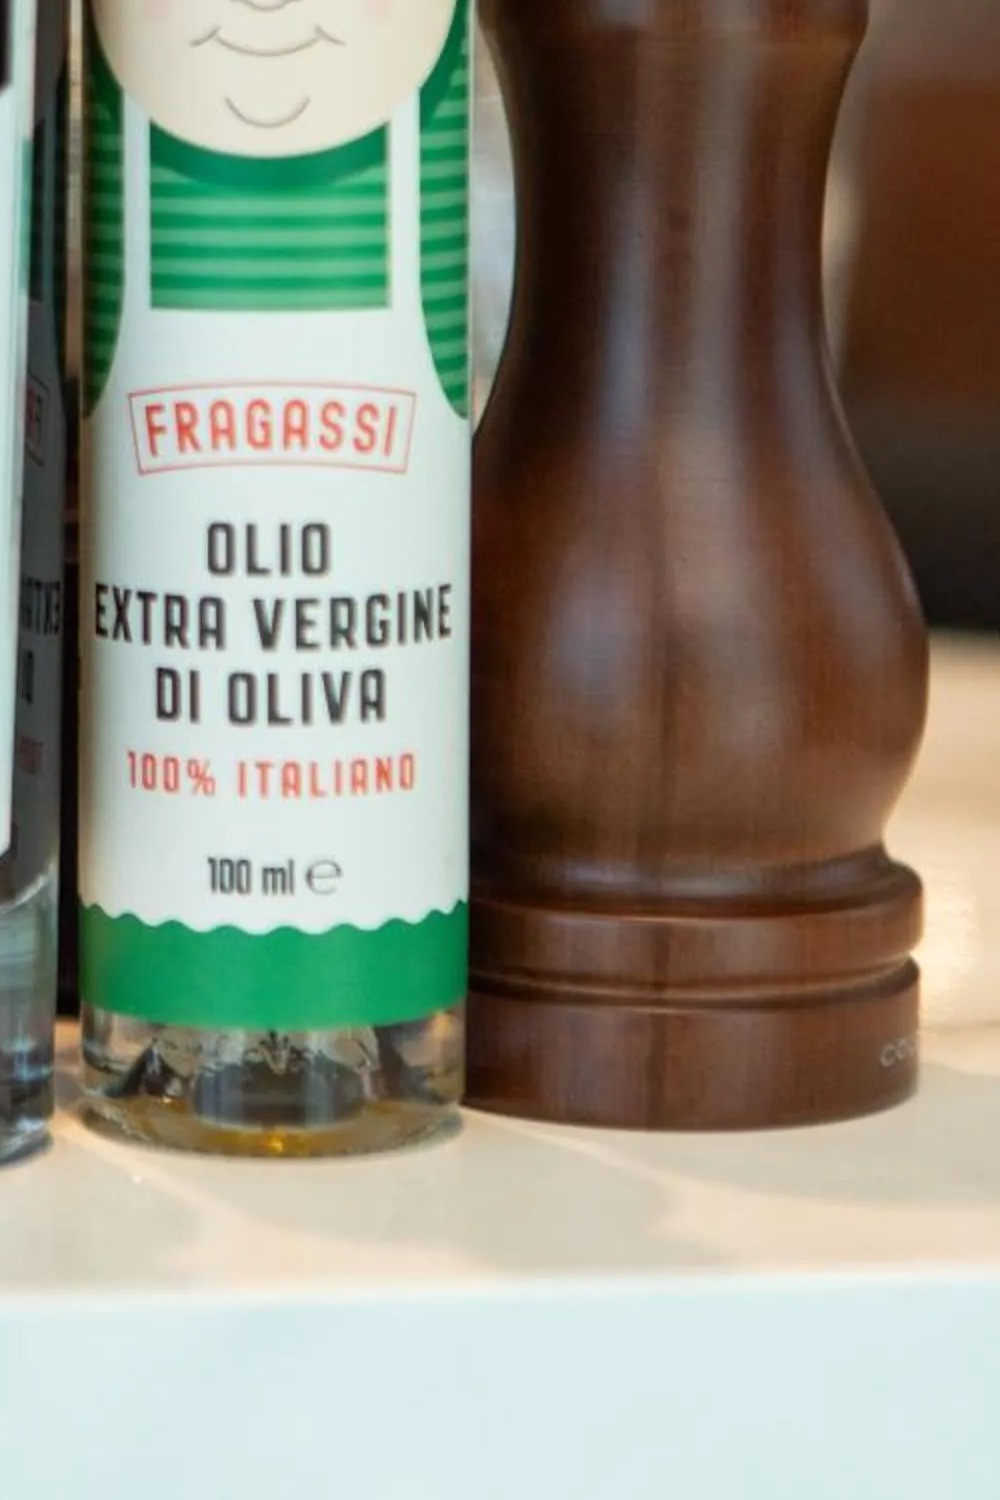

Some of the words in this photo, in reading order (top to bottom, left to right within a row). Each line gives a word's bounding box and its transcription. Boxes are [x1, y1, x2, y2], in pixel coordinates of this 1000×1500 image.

[143, 398, 399, 457] FRAGASSI
[206, 521, 332, 577] OLIO
[94, 581, 226, 651] EXTRA
[253, 582, 452, 653] VERGINE
[154, 666, 201, 724] DI
[227, 667, 388, 727] OLIVA
[126, 749, 216, 798] 100%
[237, 752, 416, 799] ITALIANO
[207, 856, 252, 896] 100
[261, 857, 296, 896] ml
